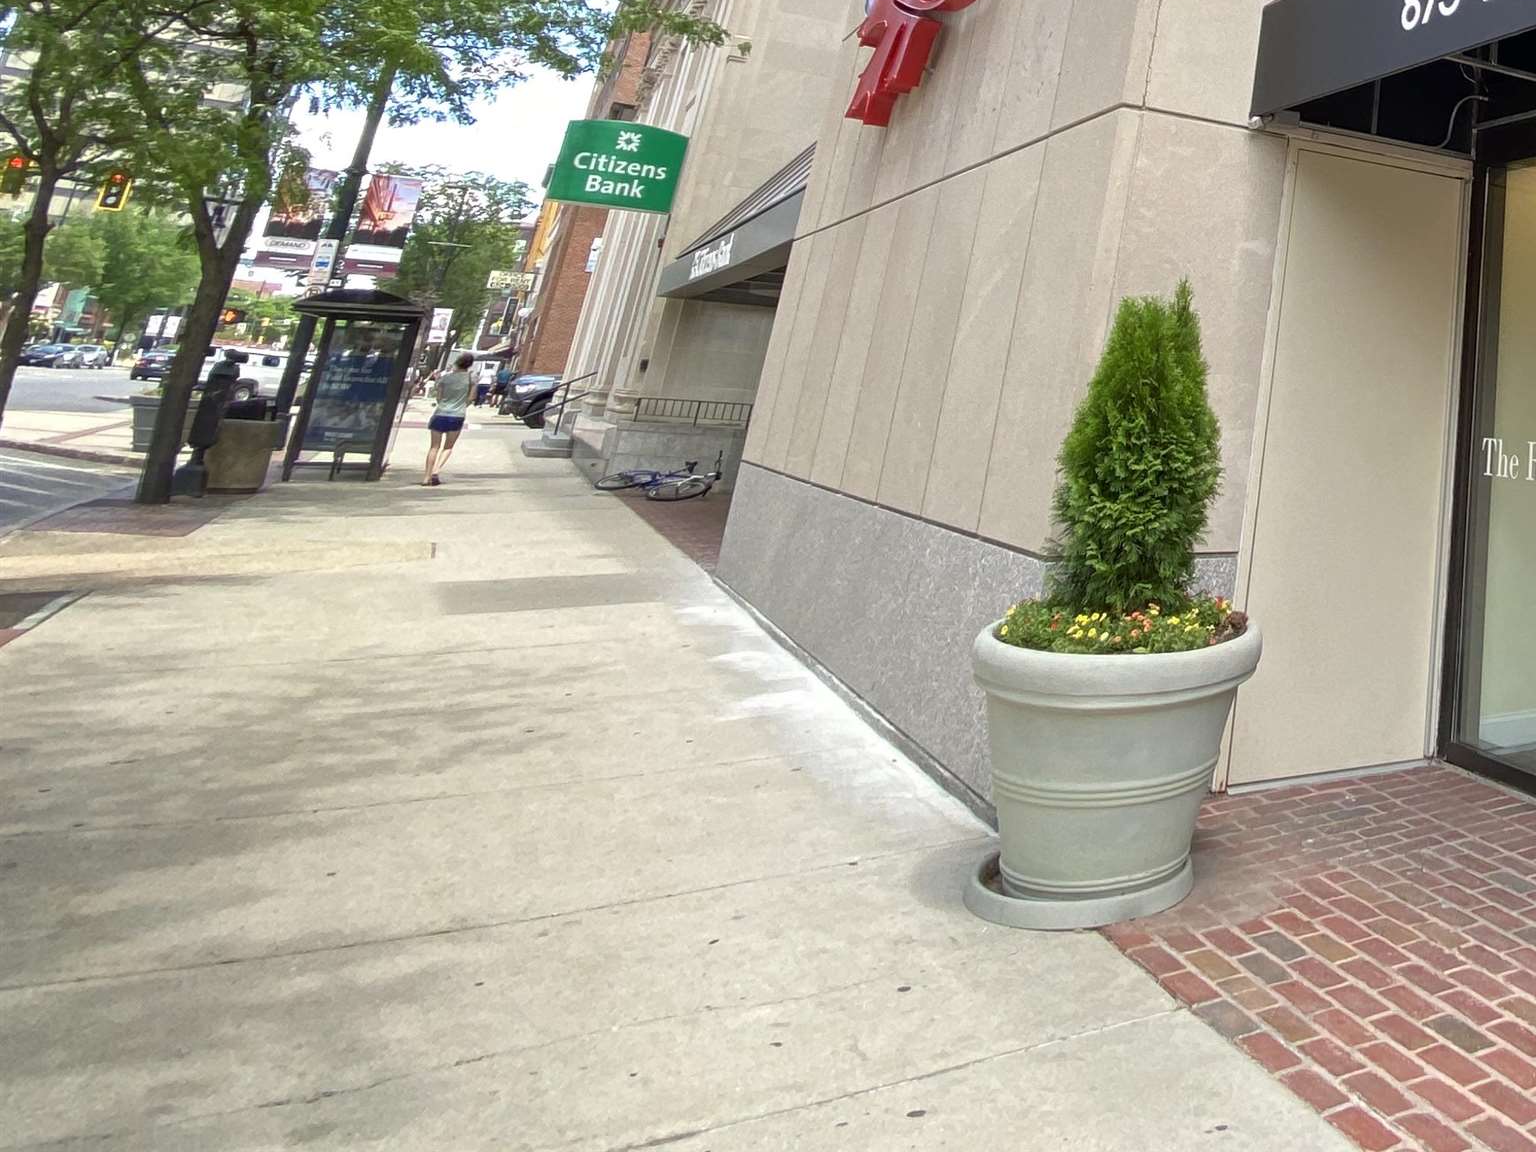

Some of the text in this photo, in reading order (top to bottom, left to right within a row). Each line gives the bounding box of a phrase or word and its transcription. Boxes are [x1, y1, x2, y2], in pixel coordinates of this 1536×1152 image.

[573, 151, 667, 180] Citizens
[584, 174, 645, 198] Bank
[1482, 437, 1519, 480] The
